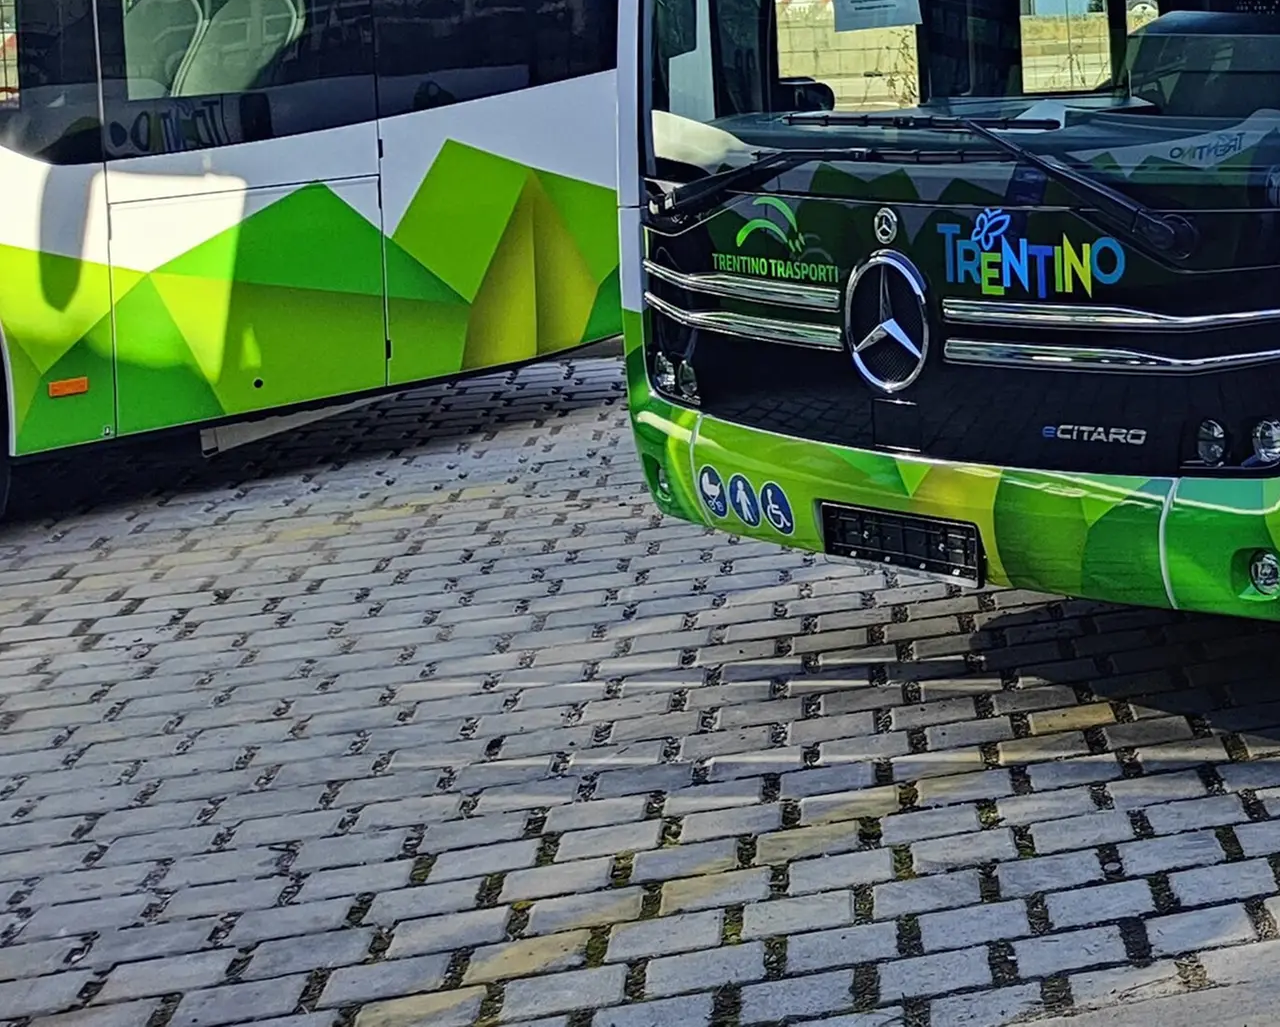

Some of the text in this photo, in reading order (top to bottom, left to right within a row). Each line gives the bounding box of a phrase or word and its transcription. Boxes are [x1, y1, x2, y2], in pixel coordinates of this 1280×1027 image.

[712, 253, 839, 283] TRENTINO TRASPORTI
[937, 223, 1126, 299] TRENTINO
[1042, 424, 1147, 445] eCITARO
